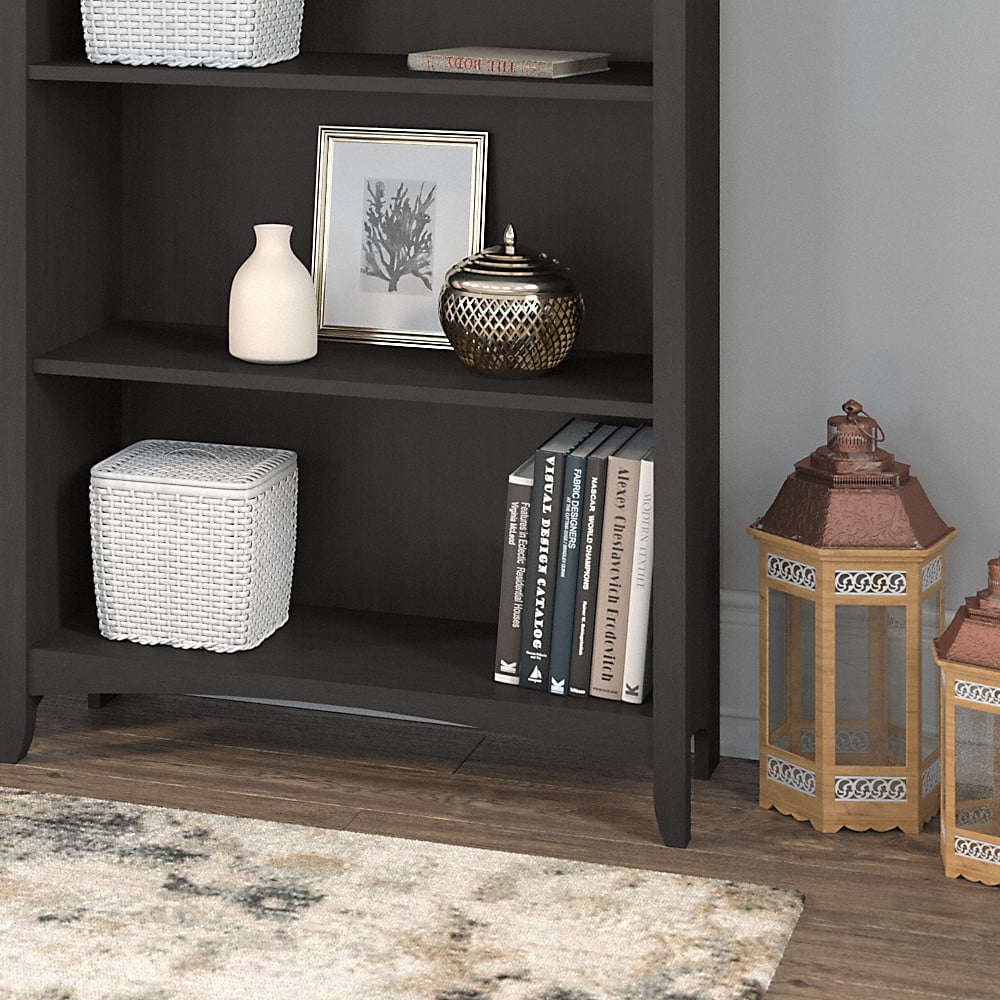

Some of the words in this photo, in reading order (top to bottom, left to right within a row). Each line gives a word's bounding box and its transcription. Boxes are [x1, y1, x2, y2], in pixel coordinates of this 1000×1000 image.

[542, 455, 556, 514] VISUAL
[571, 468, 582, 499] FABRIC
[588, 476, 598, 512] NASCAR
[615, 467, 630, 508] Alexey
[508, 522, 518, 545] McLeod
[519, 502, 531, 531] Features
[567, 500, 580, 549] DESIGNERS
[586, 515, 595, 544] WORLD
[640, 492, 652, 541] MODERN
[517, 539, 528, 565] Eclectic
[537, 518, 551, 575] DESIGN
[514, 566, 526, 602] Residential
[582, 545, 592, 591] CHAMPIONS
[512, 602, 523, 628] Houses
[532, 577, 547, 649] CATALOG
